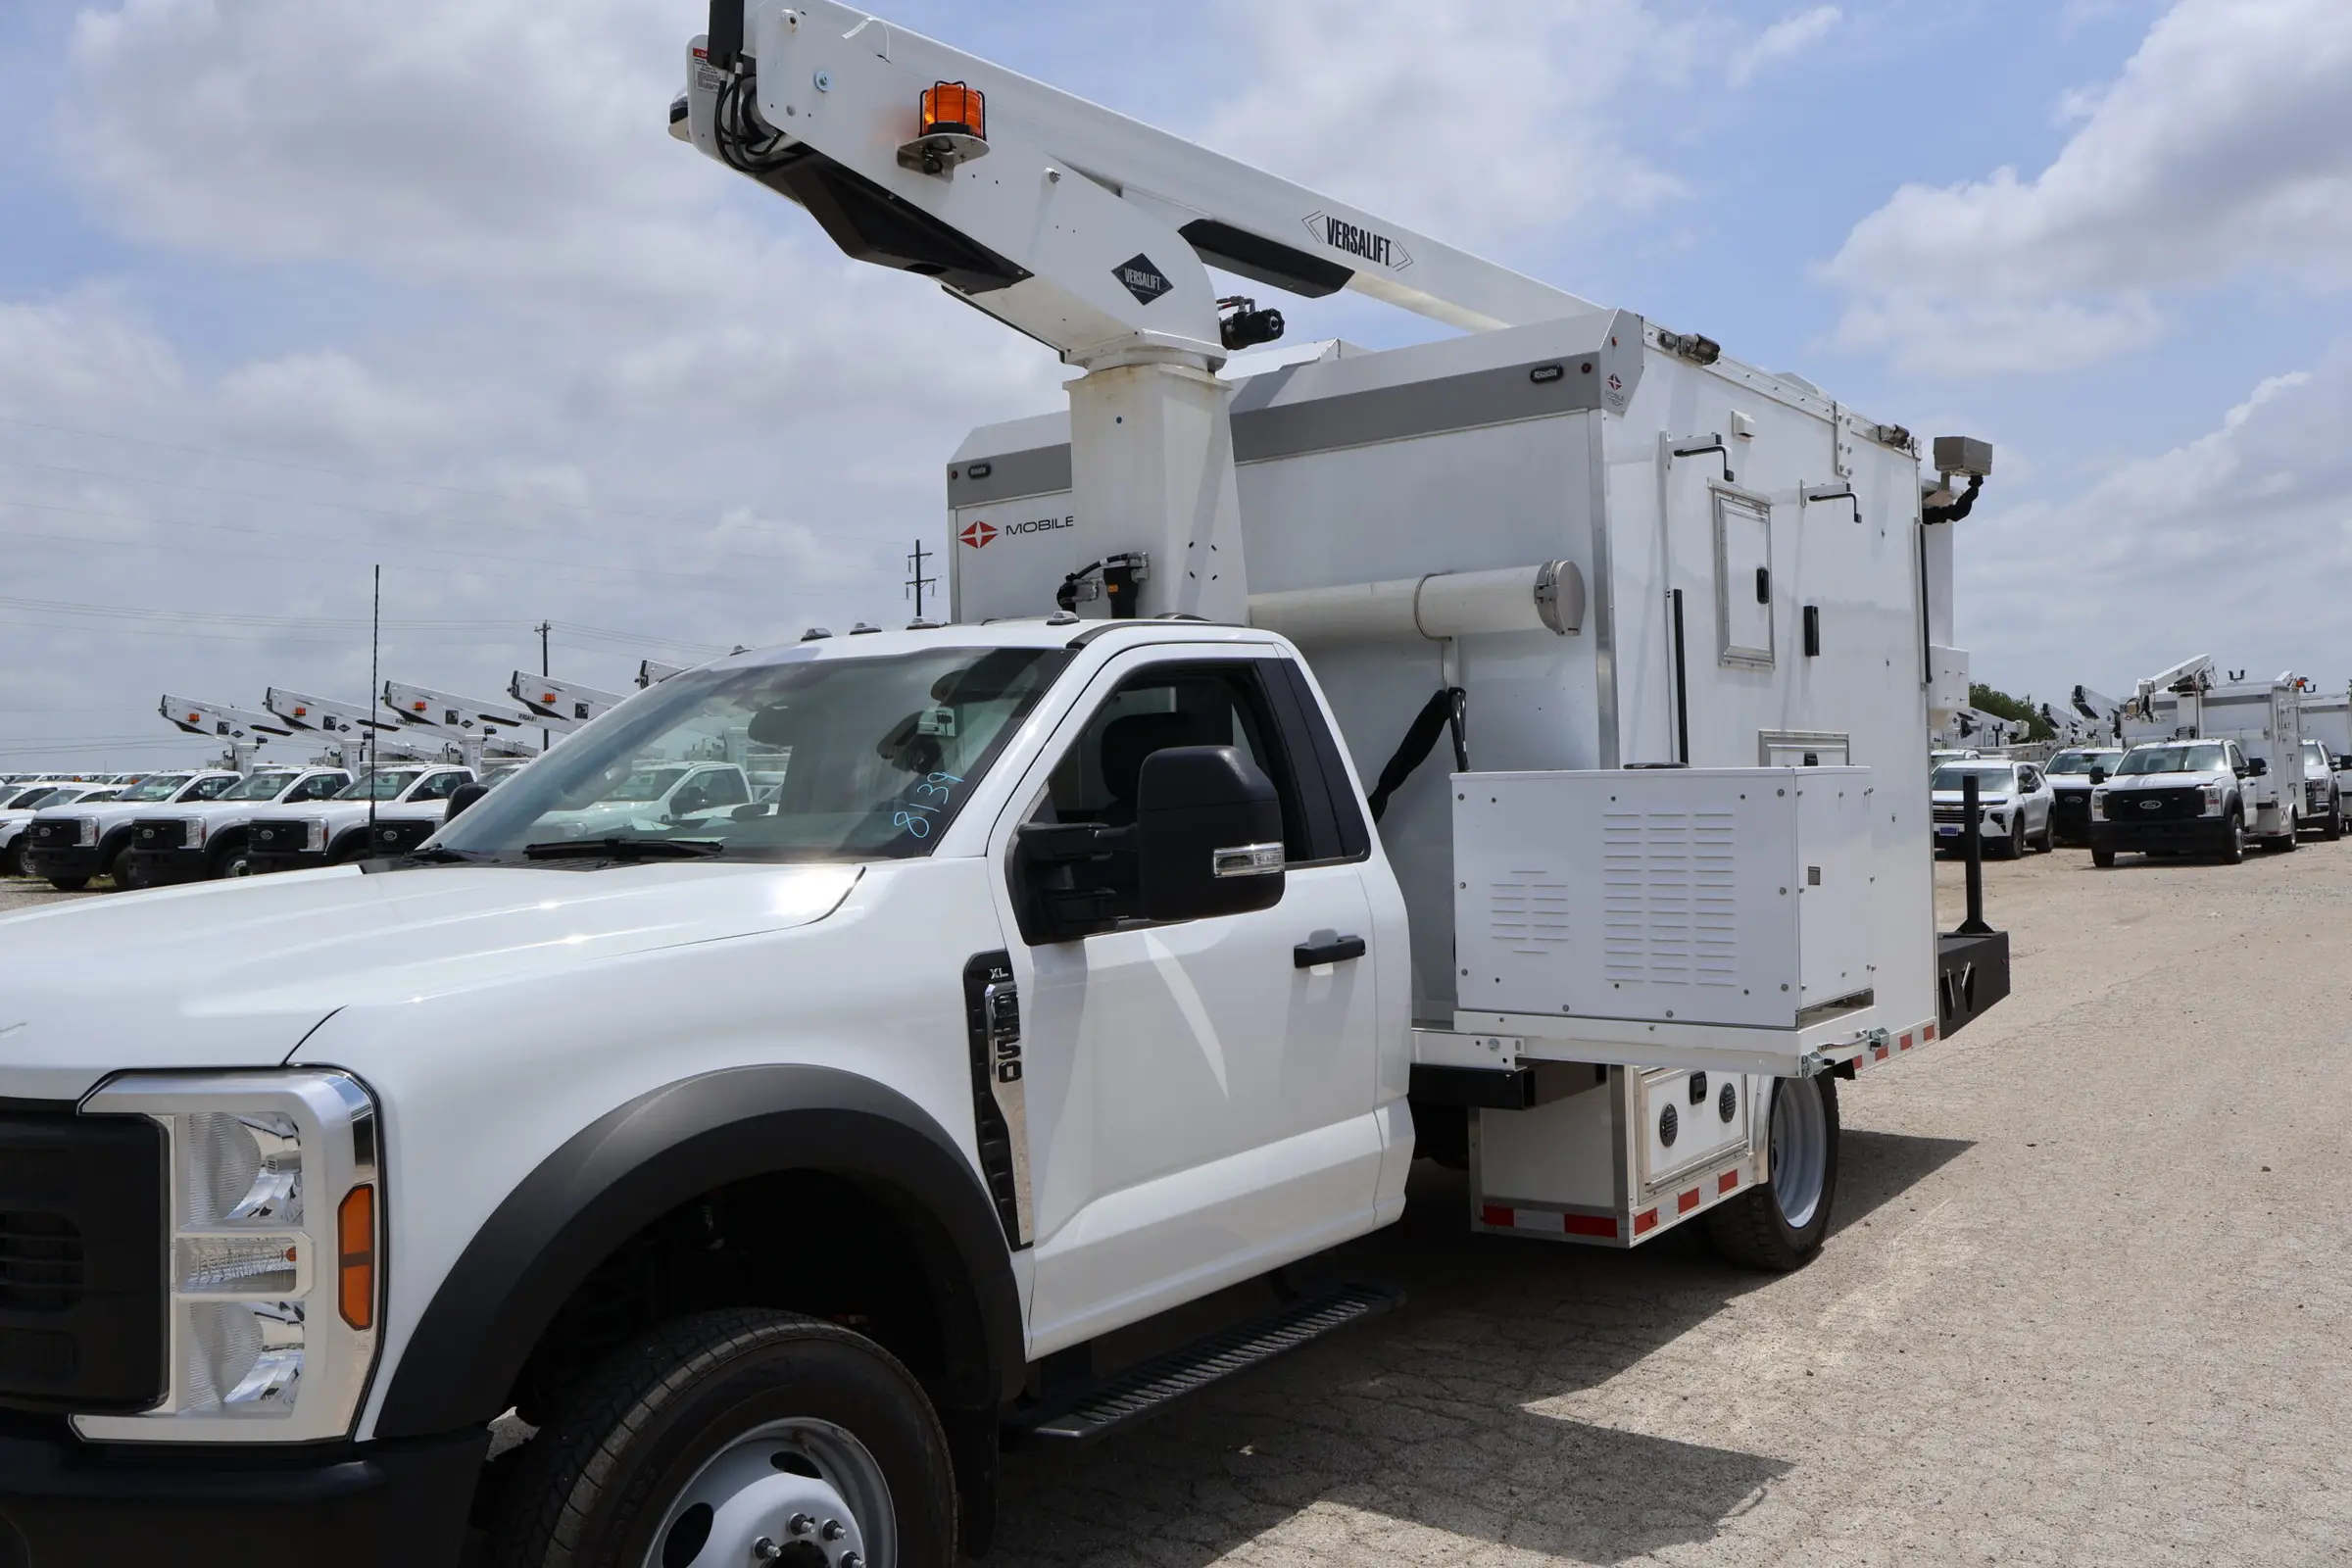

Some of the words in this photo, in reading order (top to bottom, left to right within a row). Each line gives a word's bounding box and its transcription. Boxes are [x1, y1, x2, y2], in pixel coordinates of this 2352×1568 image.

[1326, 216, 1391, 267] VERSALIFT
[1124, 267, 1160, 291] VERSALIFT
[1005, 515, 1074, 536] MOBILE
[990, 967, 1009, 980] XL
